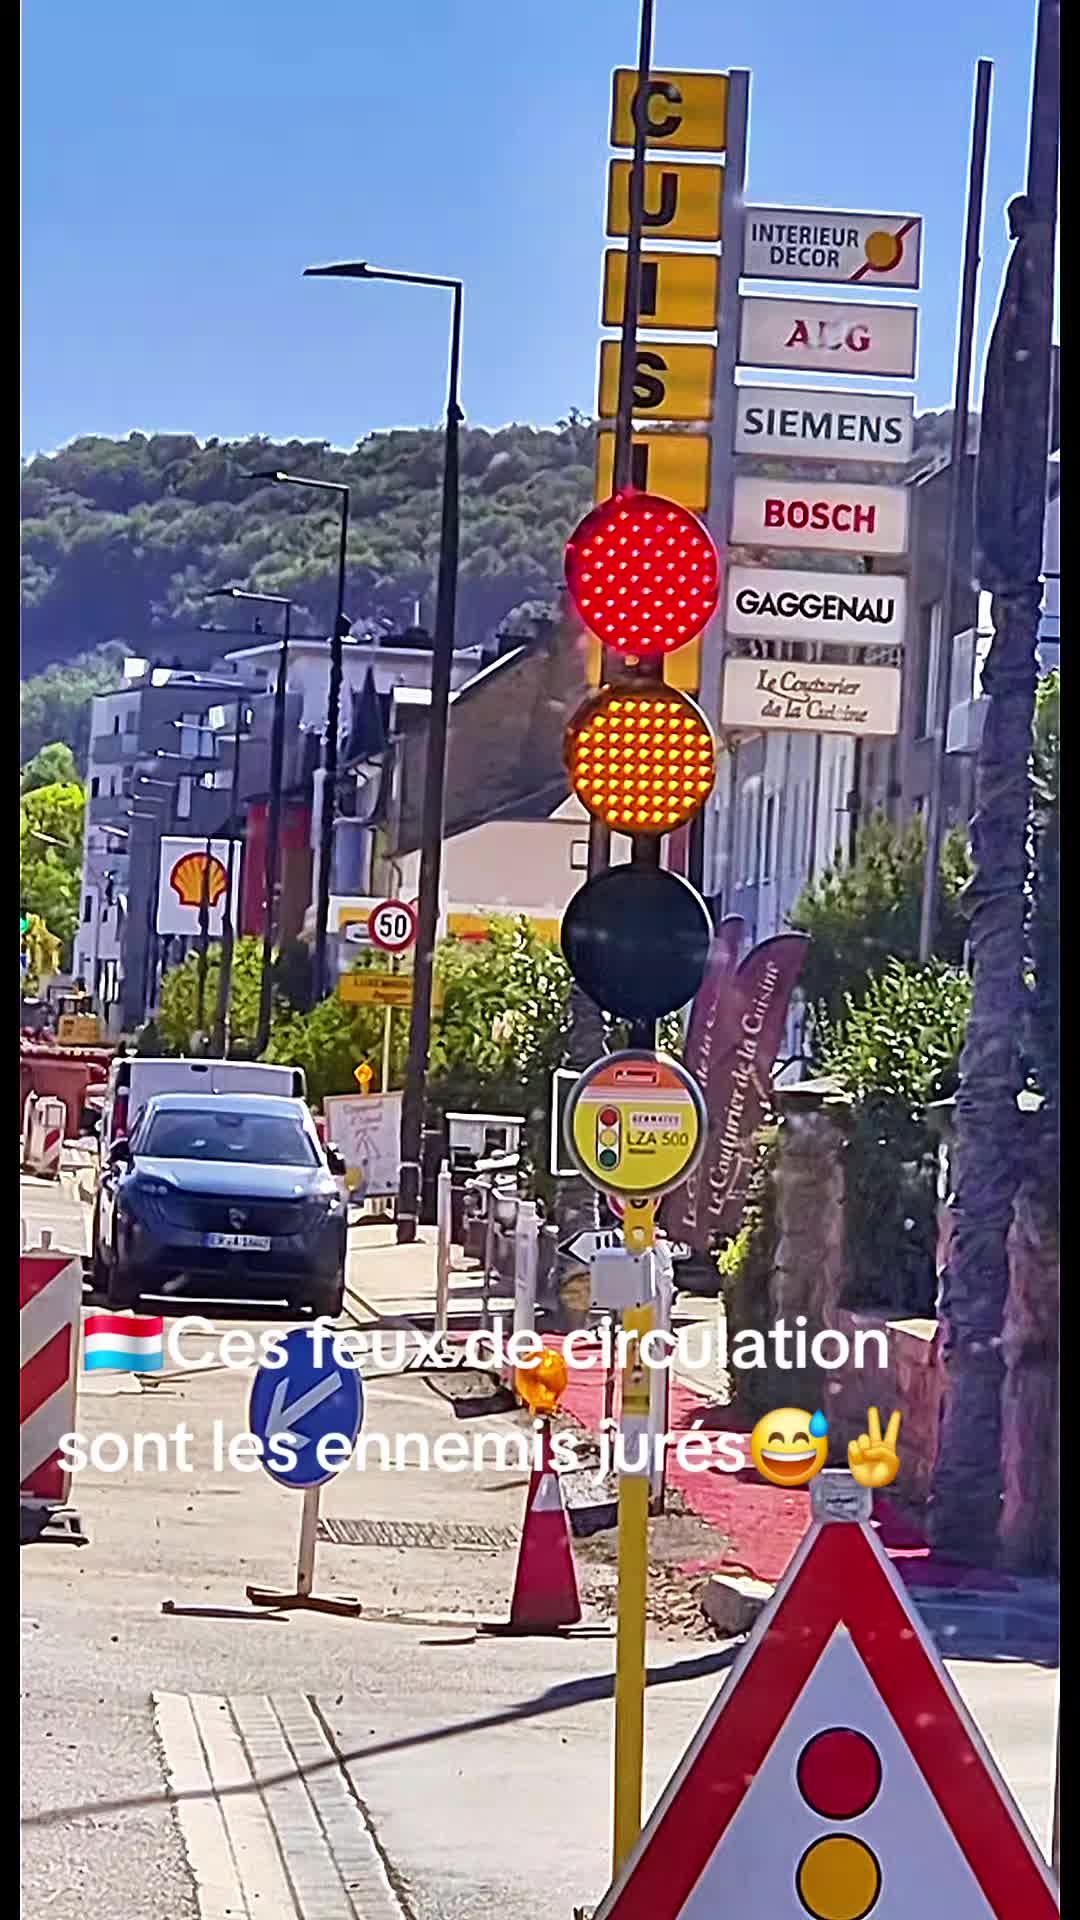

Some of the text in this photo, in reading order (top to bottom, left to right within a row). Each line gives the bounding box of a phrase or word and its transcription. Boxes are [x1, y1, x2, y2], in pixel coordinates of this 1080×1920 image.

[752, 223, 859, 248] INTERIEUR
[770, 246, 839, 268] DECOR
[743, 408, 903, 444] SIEMENS
[764, 499, 876, 533] BOSCH
[736, 589, 895, 624] GAGGENAU
[756, 669, 777, 691] Le
[379, 913, 407, 938] 50
[627, 1131, 689, 1146] LZA 500
